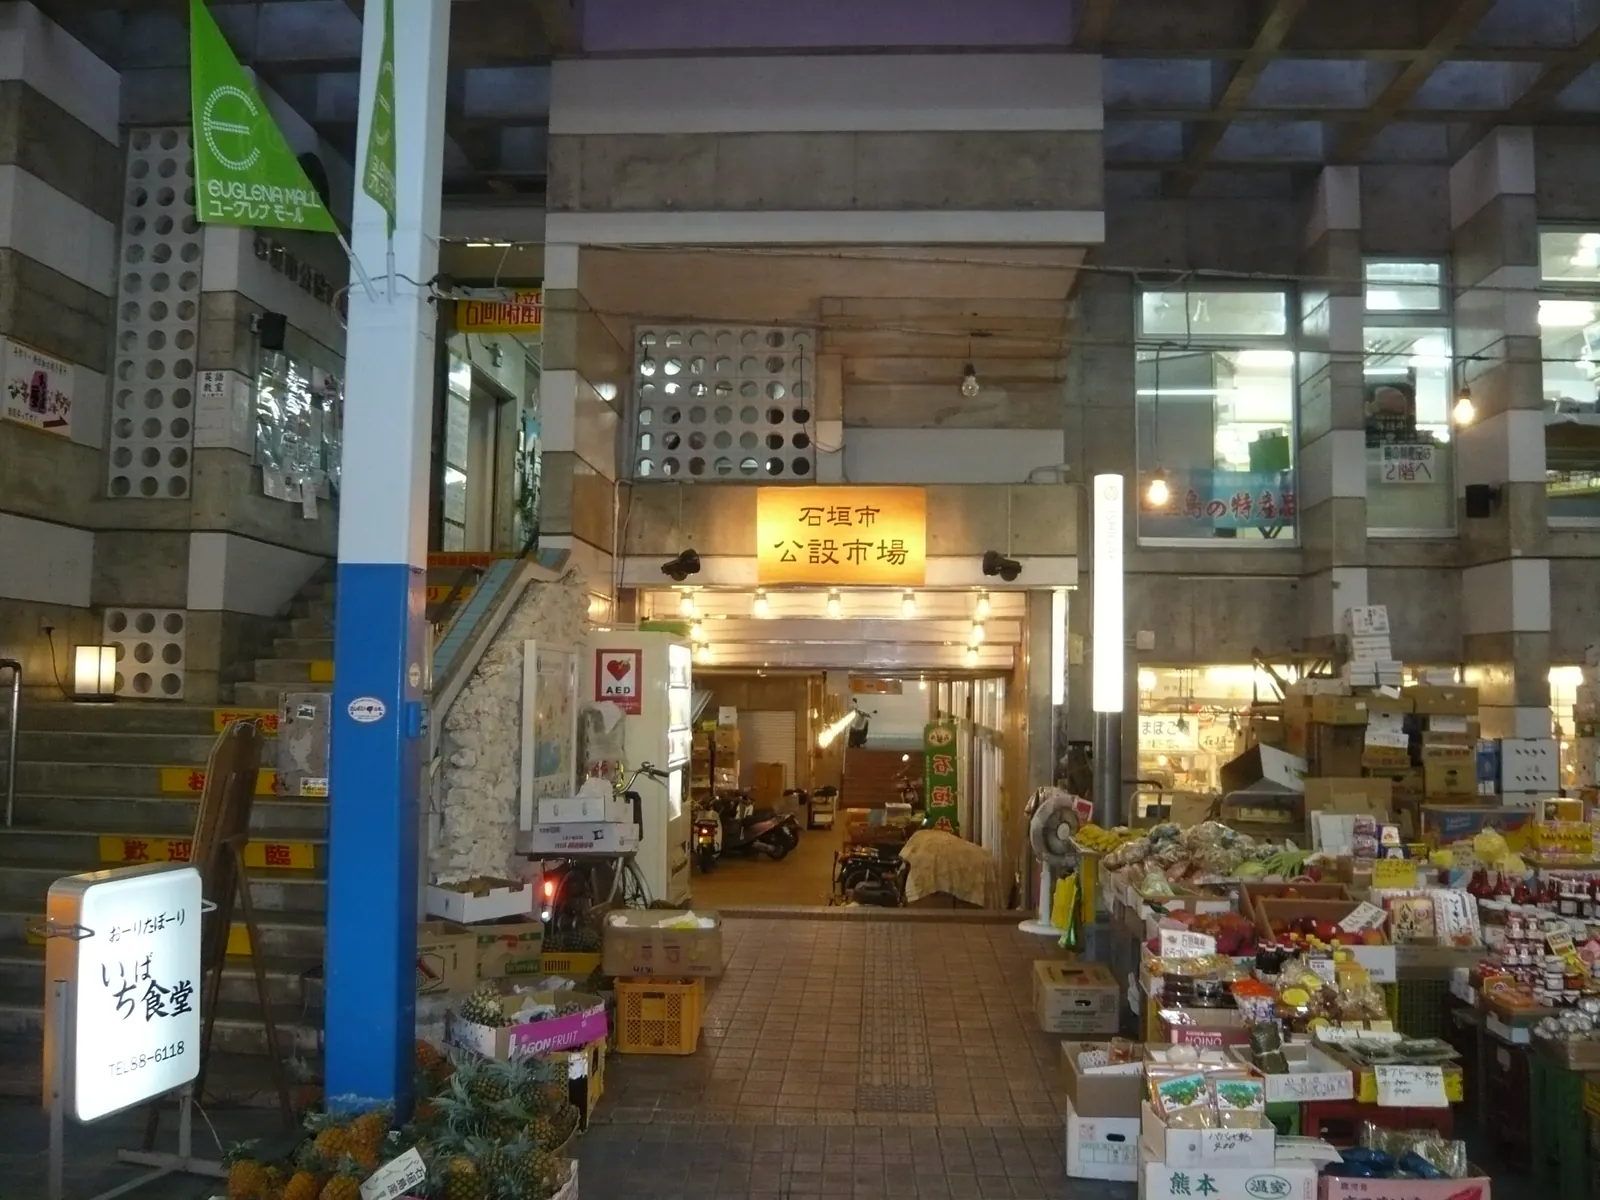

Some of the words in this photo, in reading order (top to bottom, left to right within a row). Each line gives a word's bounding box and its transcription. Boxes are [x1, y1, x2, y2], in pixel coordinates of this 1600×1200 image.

[798, 505, 880, 528] 石垣市
[774, 538, 909, 566] 公設市場
[606, 686, 631, 694] AED
[1169, 1171, 1219, 1196] 熊本
